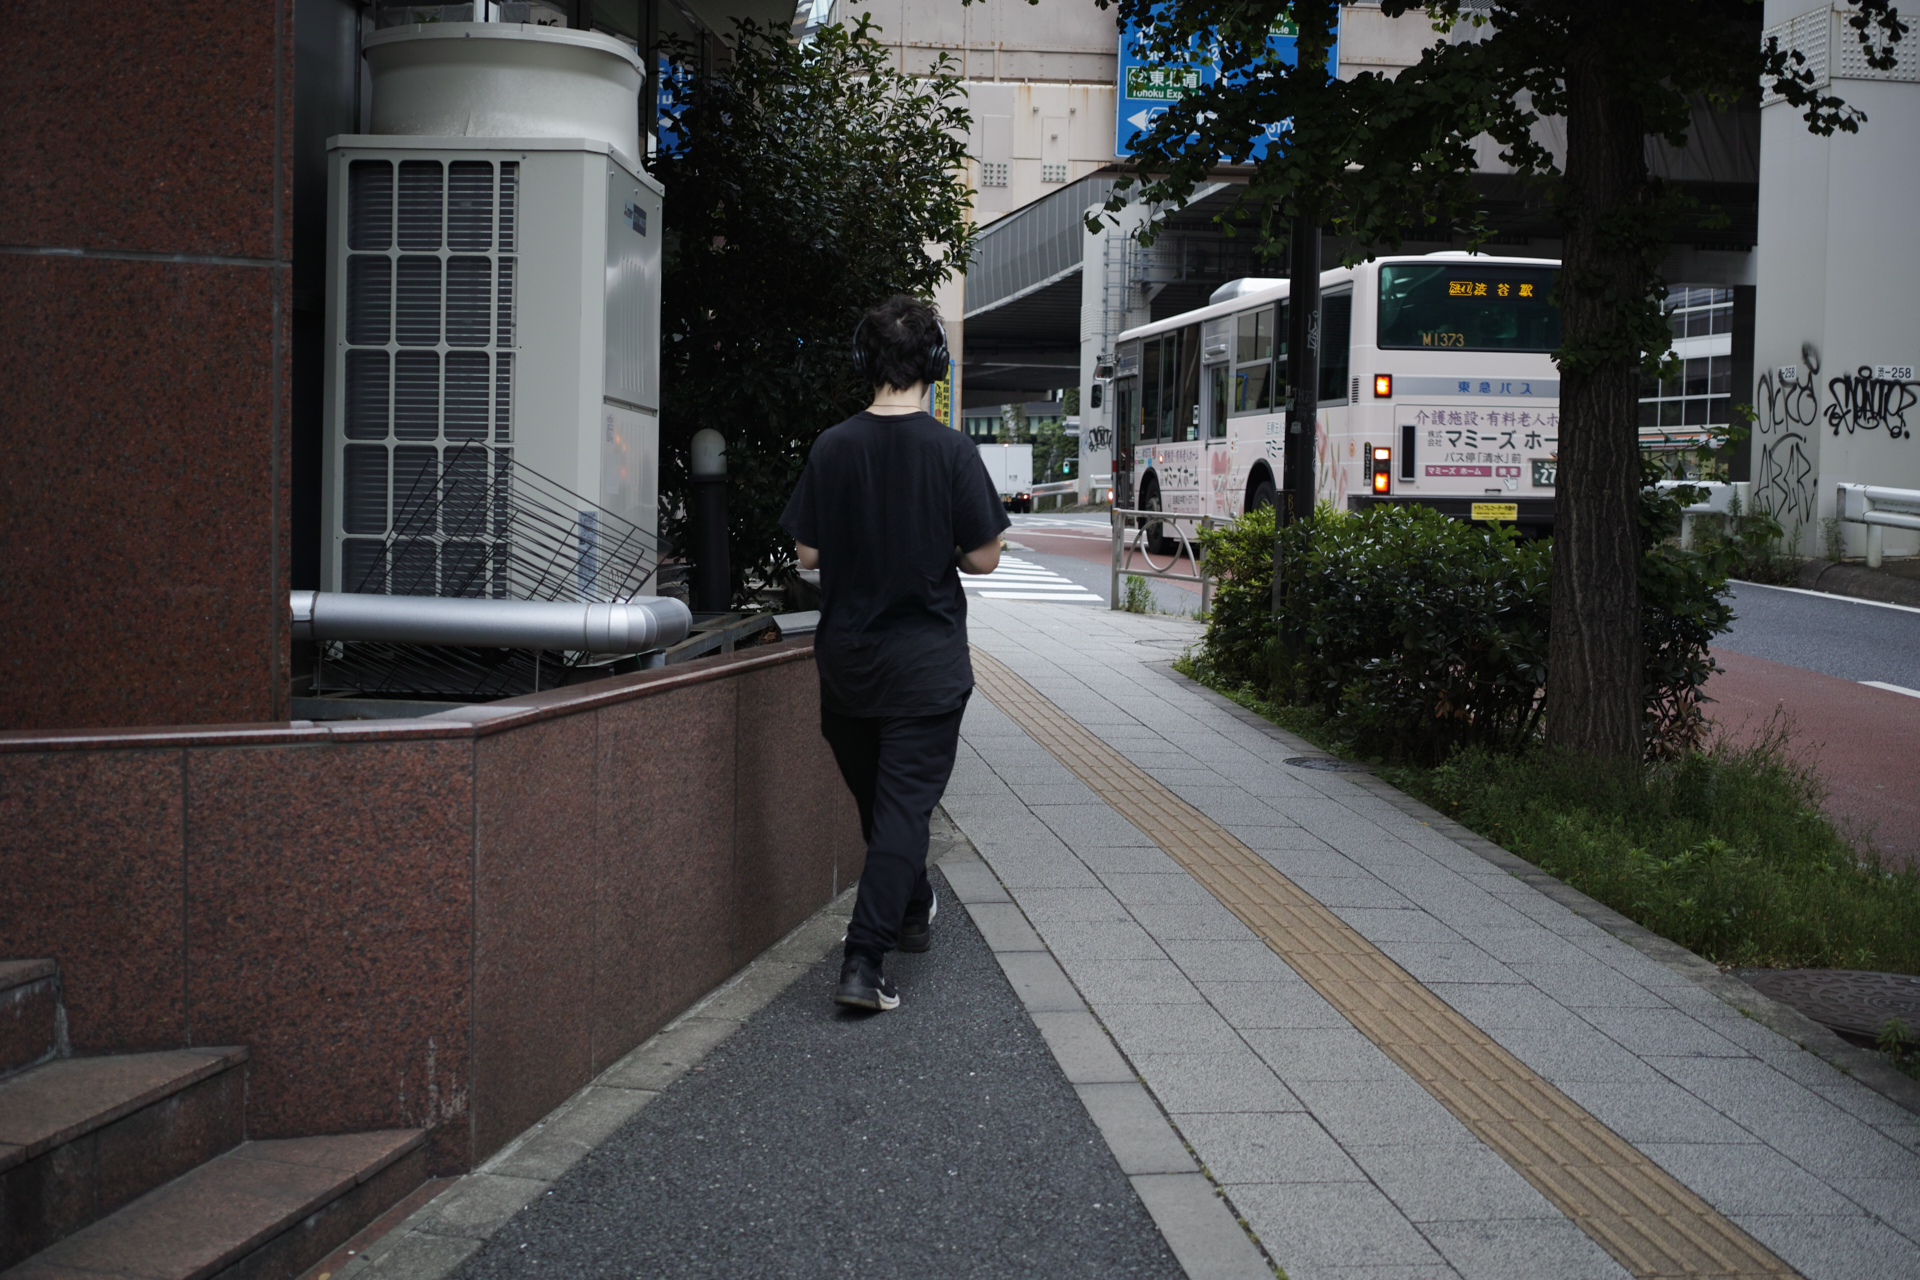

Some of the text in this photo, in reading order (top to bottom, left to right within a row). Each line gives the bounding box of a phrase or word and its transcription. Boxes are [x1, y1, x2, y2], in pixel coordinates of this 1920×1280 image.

[1473, 282, 1534, 298] 渋谷駅
[1422, 332, 1465, 347] M1373
[1457, 380, 1533, 395] 東急バス
[1445, 428, 1517, 450] マミーズ
[1265, 439, 1285, 459] マミー
